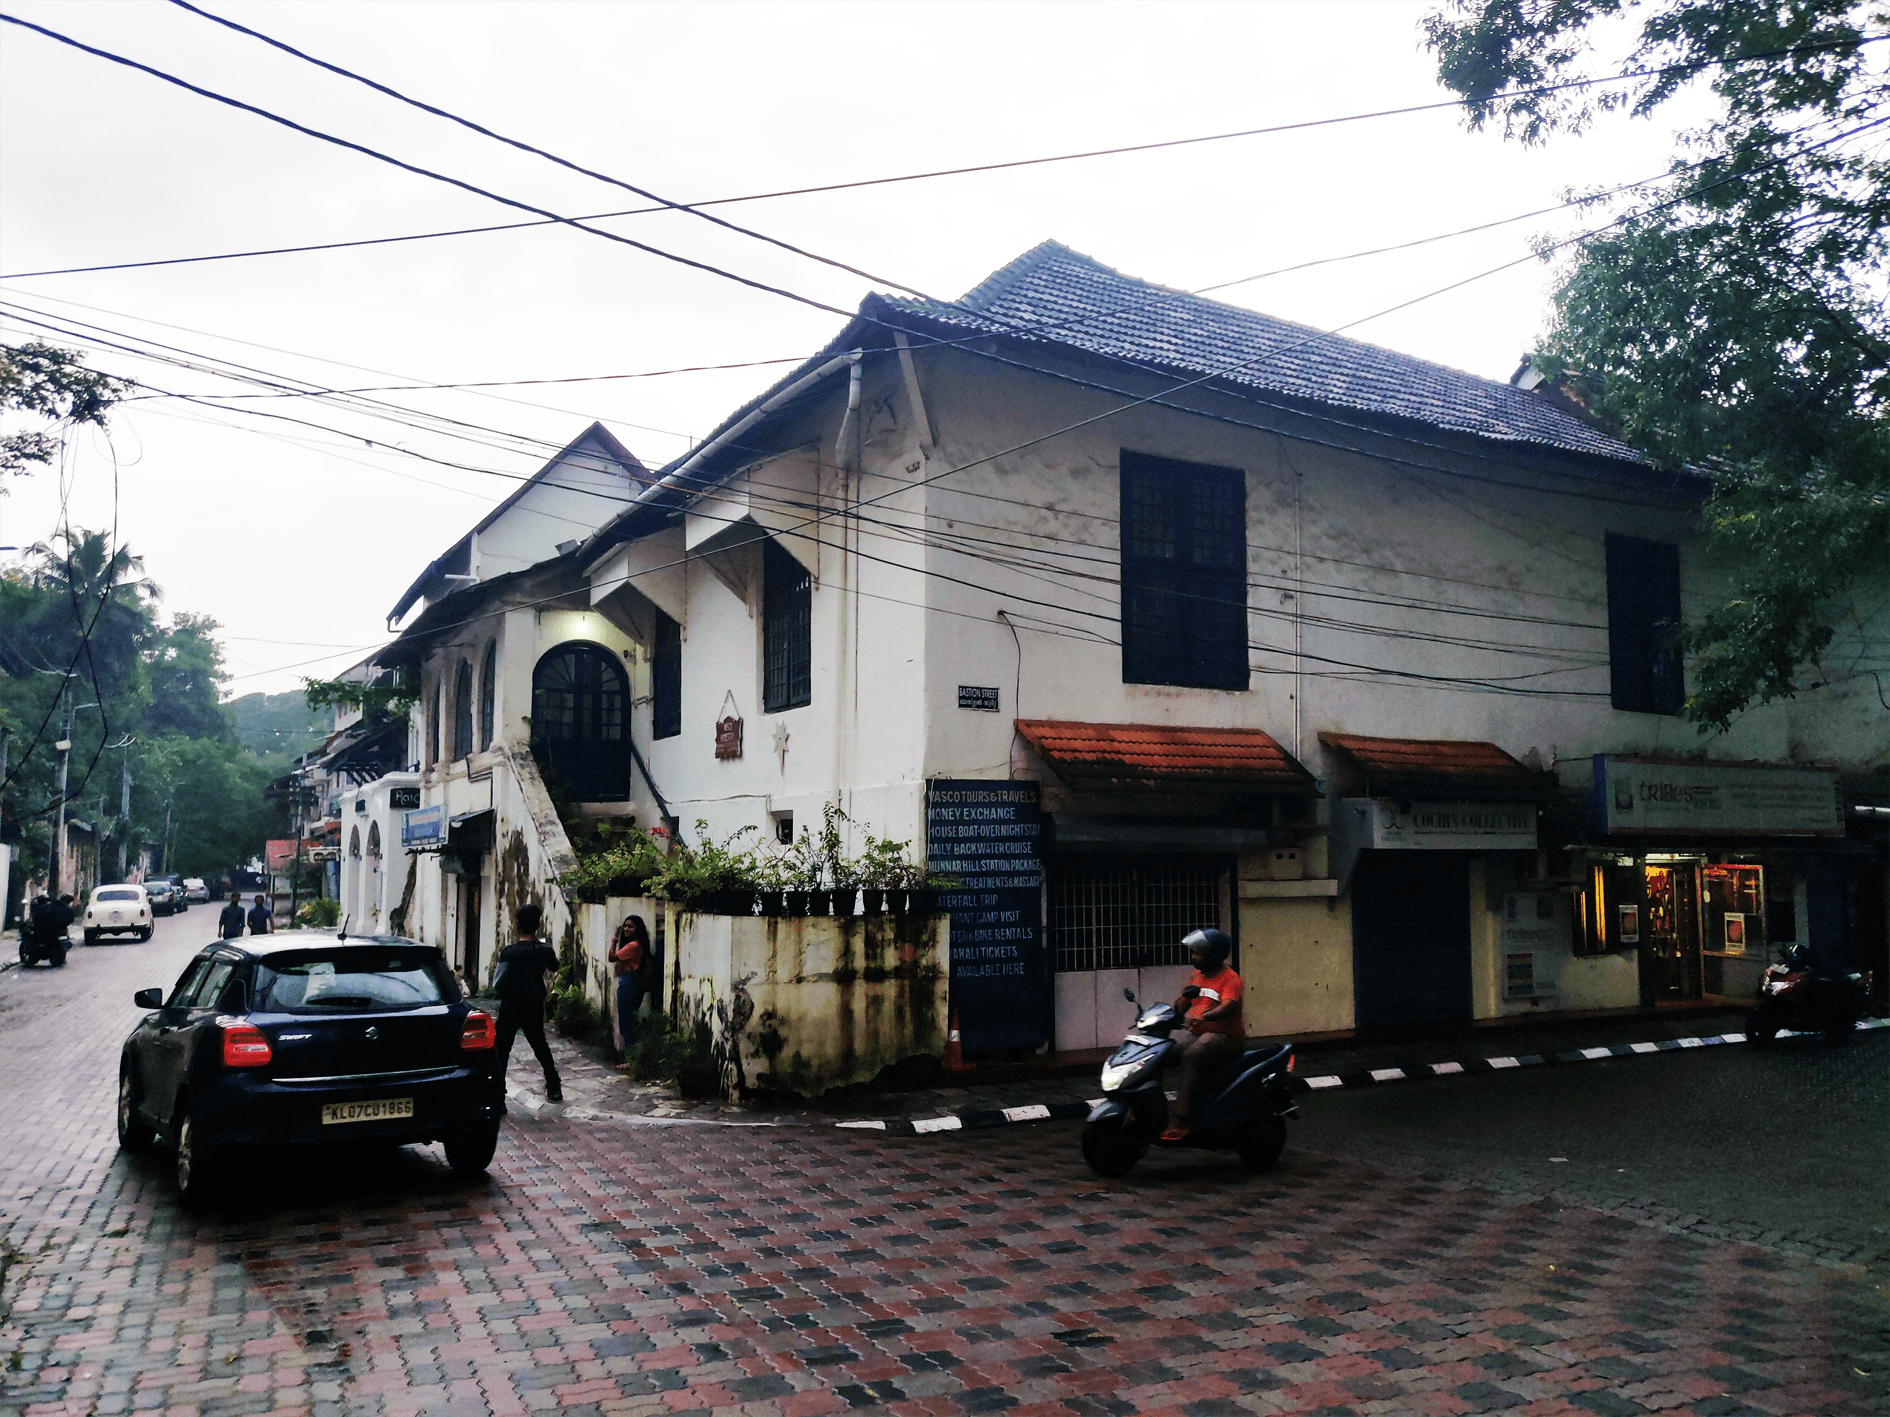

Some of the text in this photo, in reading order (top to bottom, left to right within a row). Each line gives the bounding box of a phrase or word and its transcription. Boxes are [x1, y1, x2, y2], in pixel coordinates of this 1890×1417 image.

[960, 687, 998, 699] BASTION STREET
[928, 790, 960, 803] VASCO
[963, 807, 1016, 820] EXCHANGE
[928, 826, 958, 838] HOUSE
[928, 843, 952, 855] DAILY
[1004, 841, 1033, 854] CRUISE
[928, 858, 1041, 873] MUNNAR HILL STATION PACKAGE
[936, 894, 998, 908] ATERFALL TRIP
[976, 911, 999, 924] CAMP
[1000, 910, 1020, 923] VISIT
[994, 927, 1034, 941] RENTALS
[980, 945, 1018, 959] TICKETS
[957, 962, 1025, 978] AVAILABLE HERE
